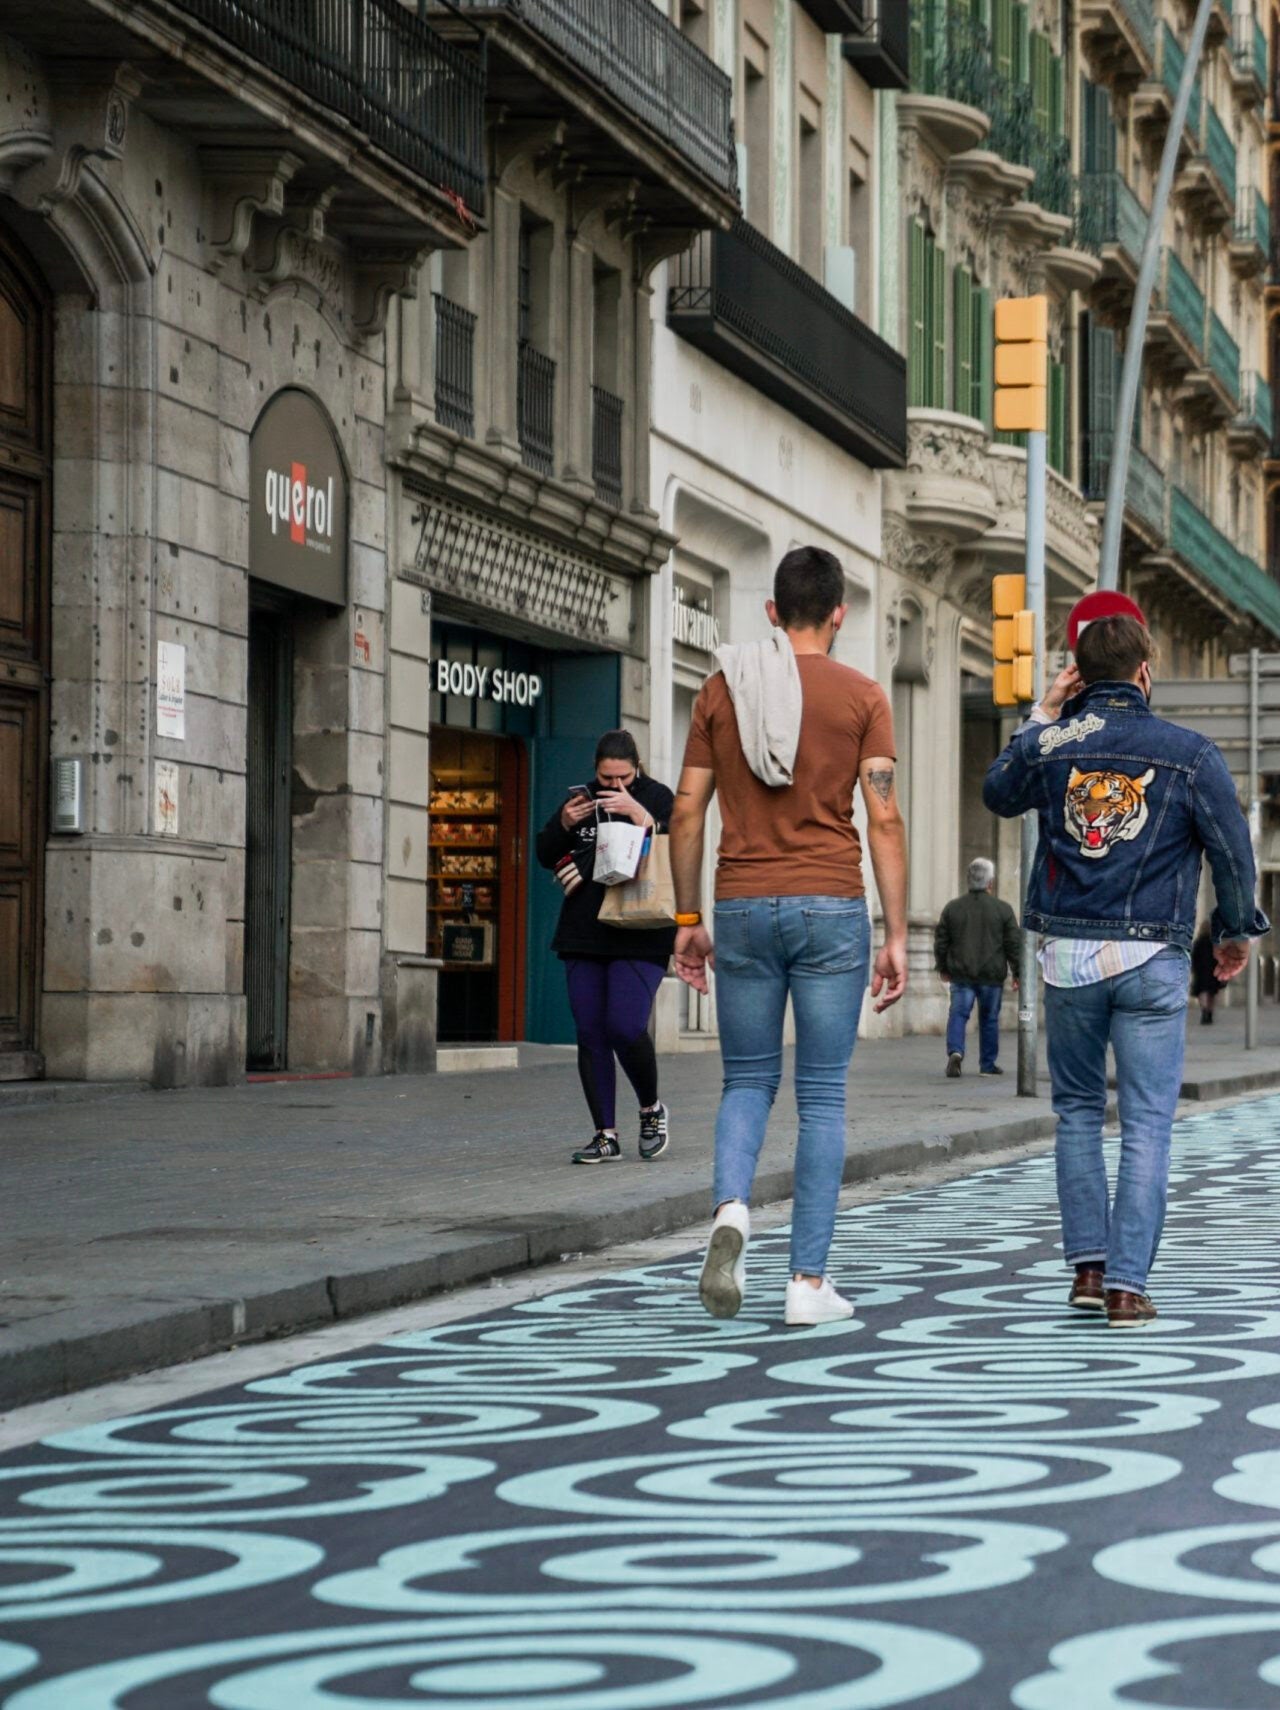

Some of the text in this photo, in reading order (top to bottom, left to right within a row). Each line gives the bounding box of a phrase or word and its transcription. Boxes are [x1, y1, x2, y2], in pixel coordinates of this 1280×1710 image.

[265, 468, 333, 537] querol
[437, 659, 542, 706] BODY SHOP
